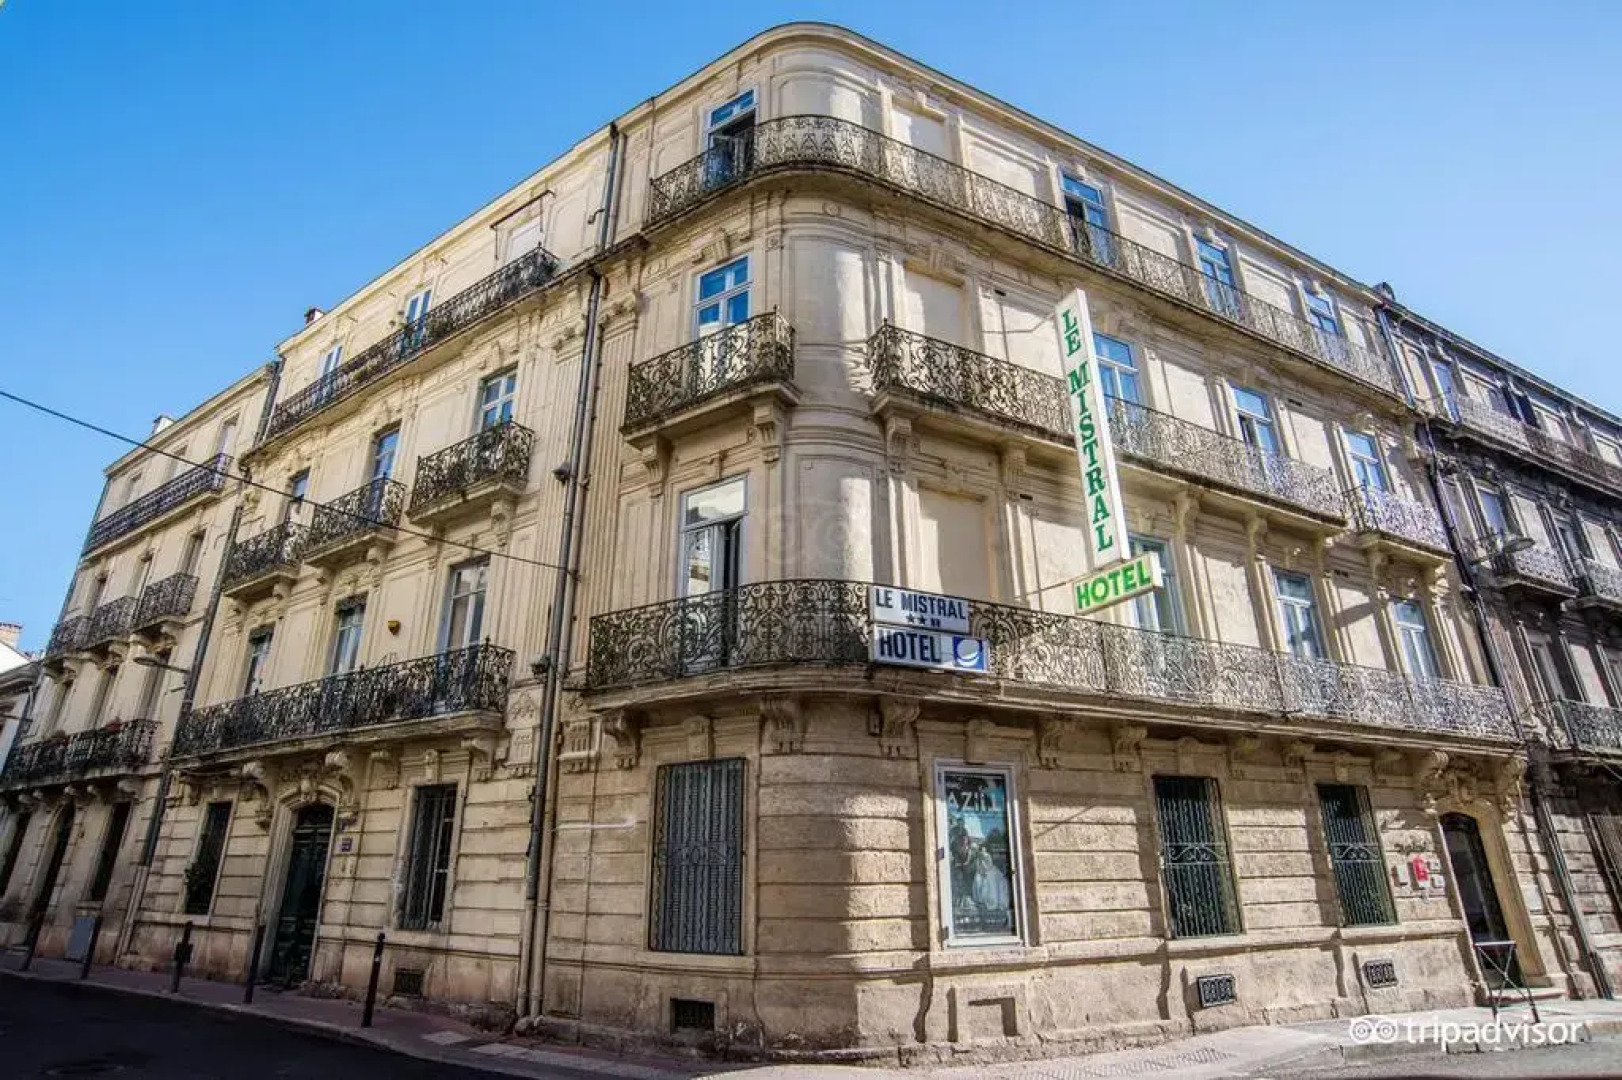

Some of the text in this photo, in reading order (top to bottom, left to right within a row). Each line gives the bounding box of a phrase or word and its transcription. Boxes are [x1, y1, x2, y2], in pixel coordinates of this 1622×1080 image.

[1062, 309, 1113, 551] LE MISTRAL
[875, 588, 966, 619] LE MISTRAL
[1076, 560, 1152, 609] HOTEL
[879, 632, 942, 663] HOTEL
